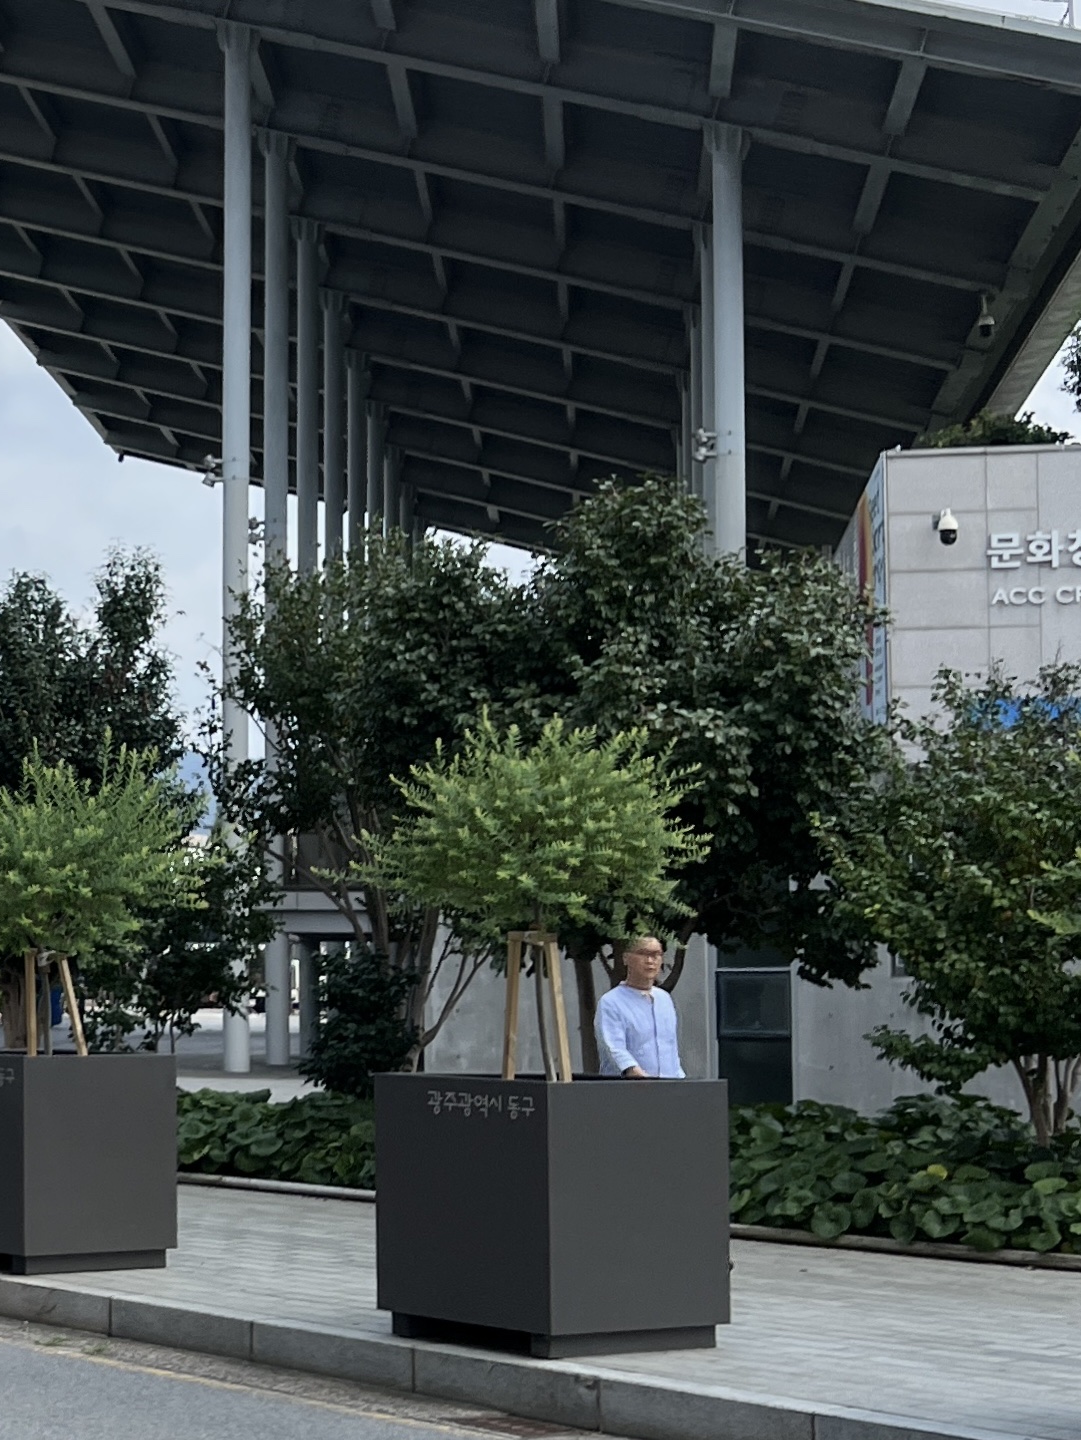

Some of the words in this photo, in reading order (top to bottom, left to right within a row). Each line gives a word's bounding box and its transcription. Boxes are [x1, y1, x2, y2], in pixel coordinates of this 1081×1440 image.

[992, 586, 1046, 605] ACC
[427, 1090, 503, 1118] 광주광역시
[507, 1095, 536, 1120] 동구
